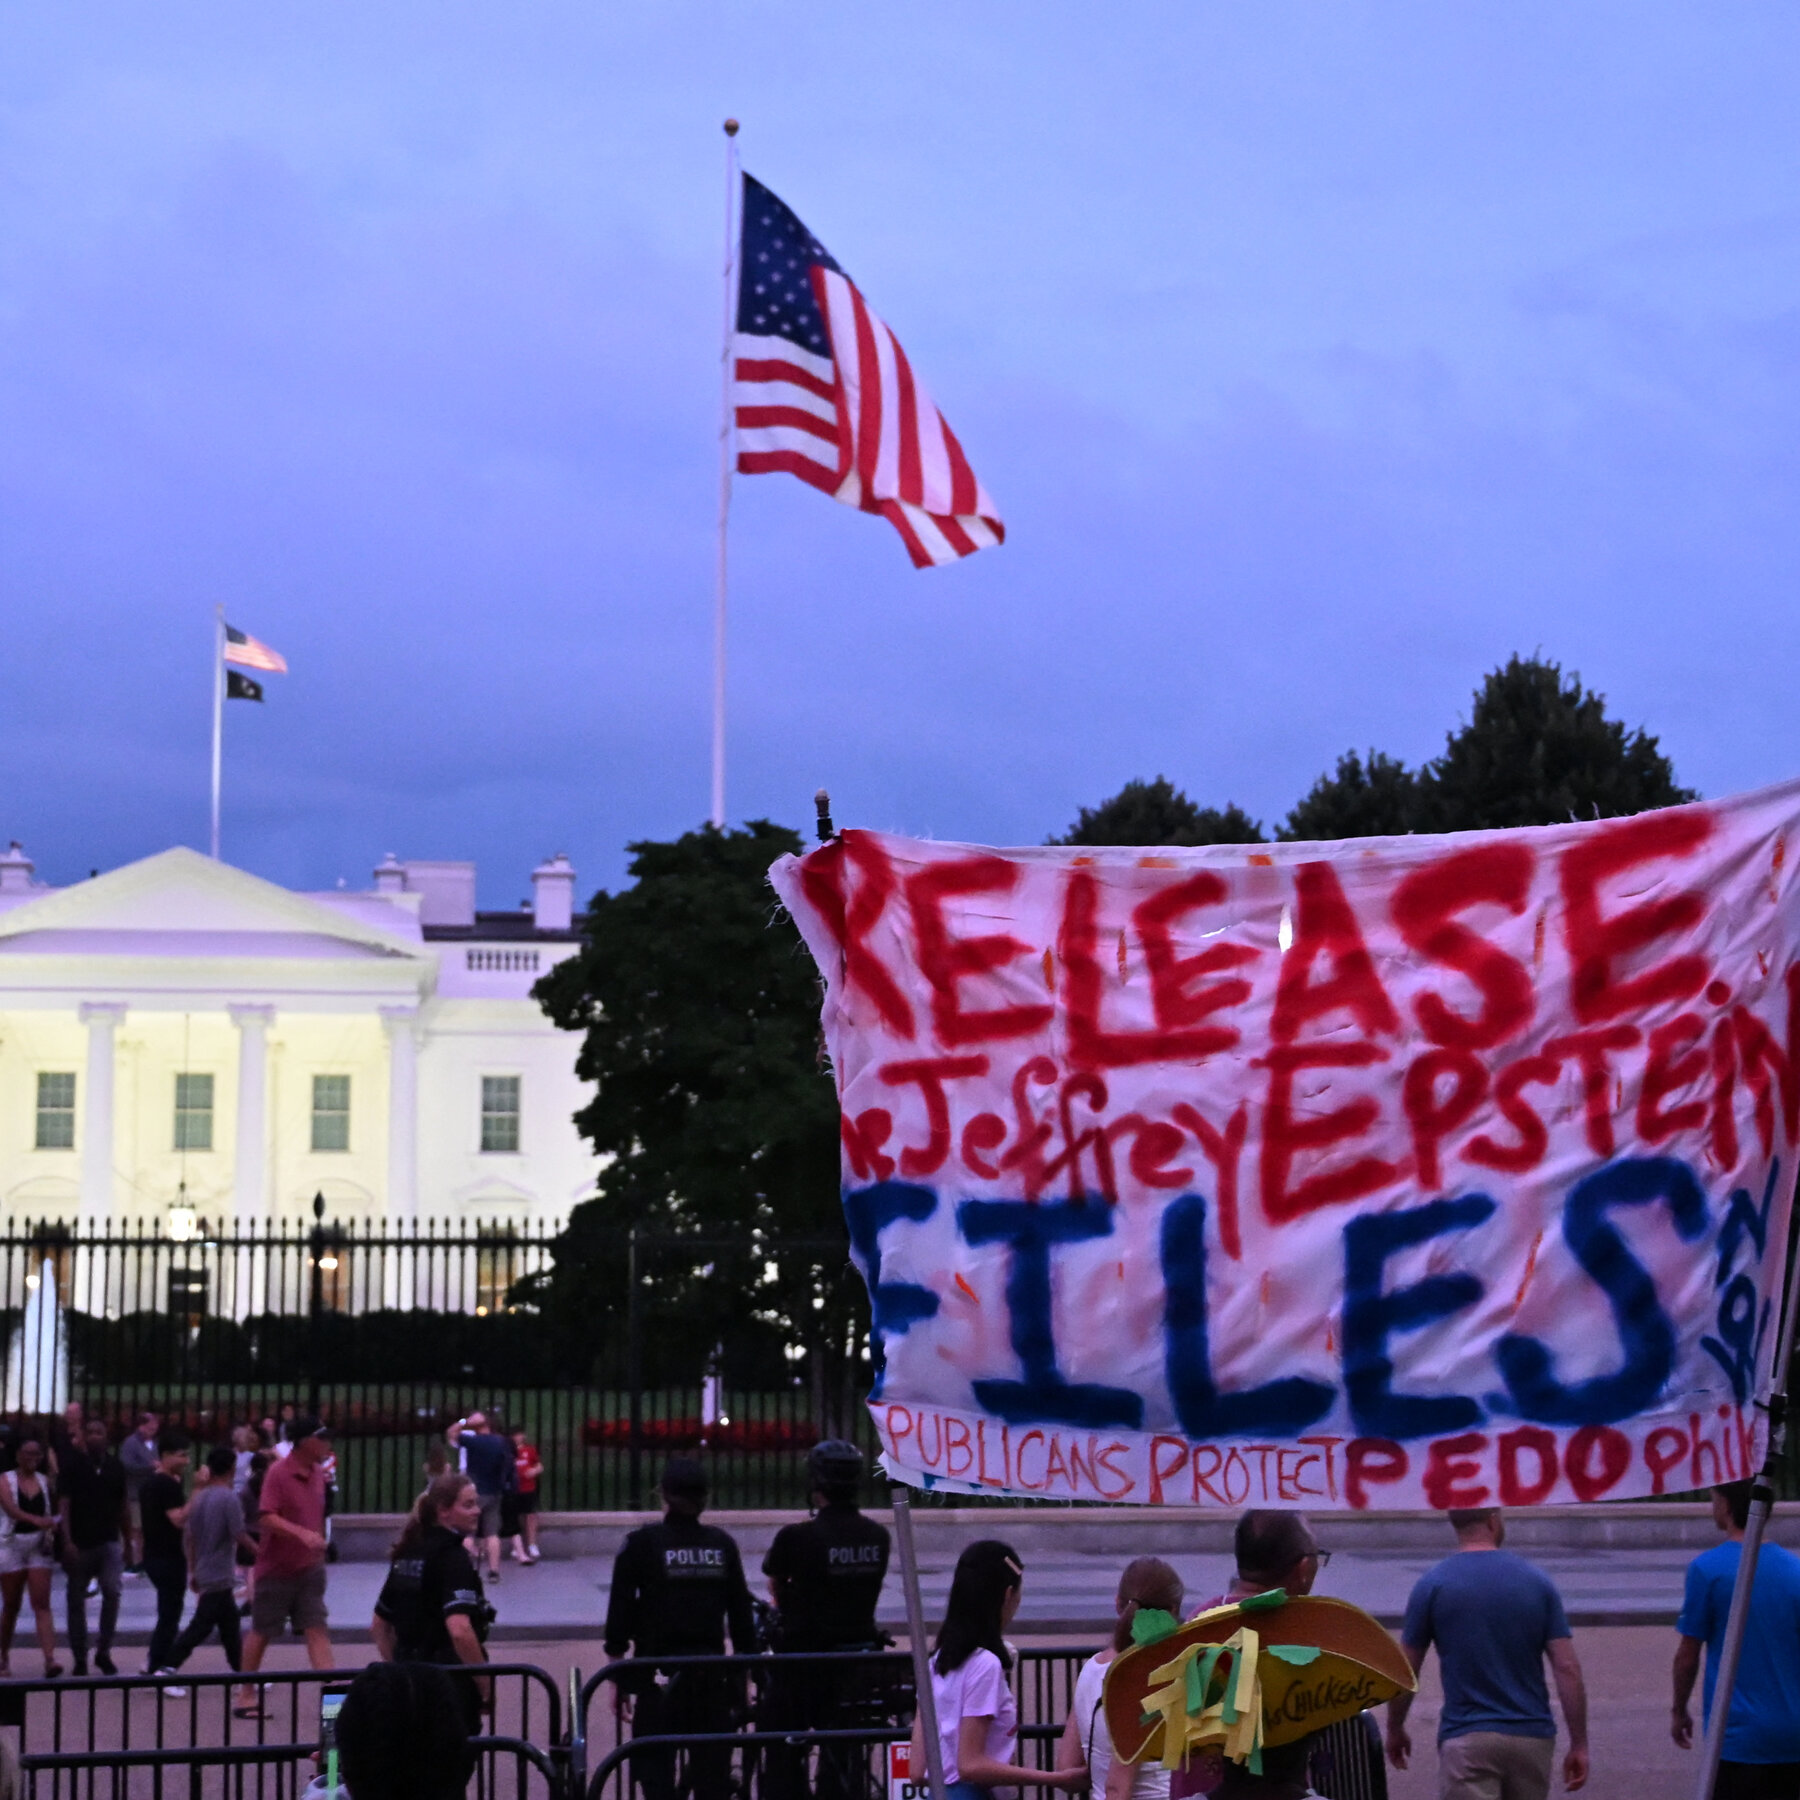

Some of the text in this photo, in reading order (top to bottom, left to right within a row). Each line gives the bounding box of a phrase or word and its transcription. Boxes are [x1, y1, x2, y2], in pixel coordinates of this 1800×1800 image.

[803, 811, 1716, 1069] RELEASE
[841, 1157, 1710, 1437] FILES
[884, 1402, 1136, 1500] PUBLICANS
[1149, 1434, 1345, 1505] PROTECT
[665, 1548, 724, 1566] POLICE
[829, 1545, 881, 1564] POLICE
[1283, 1674, 1375, 1722] CHICKENS
